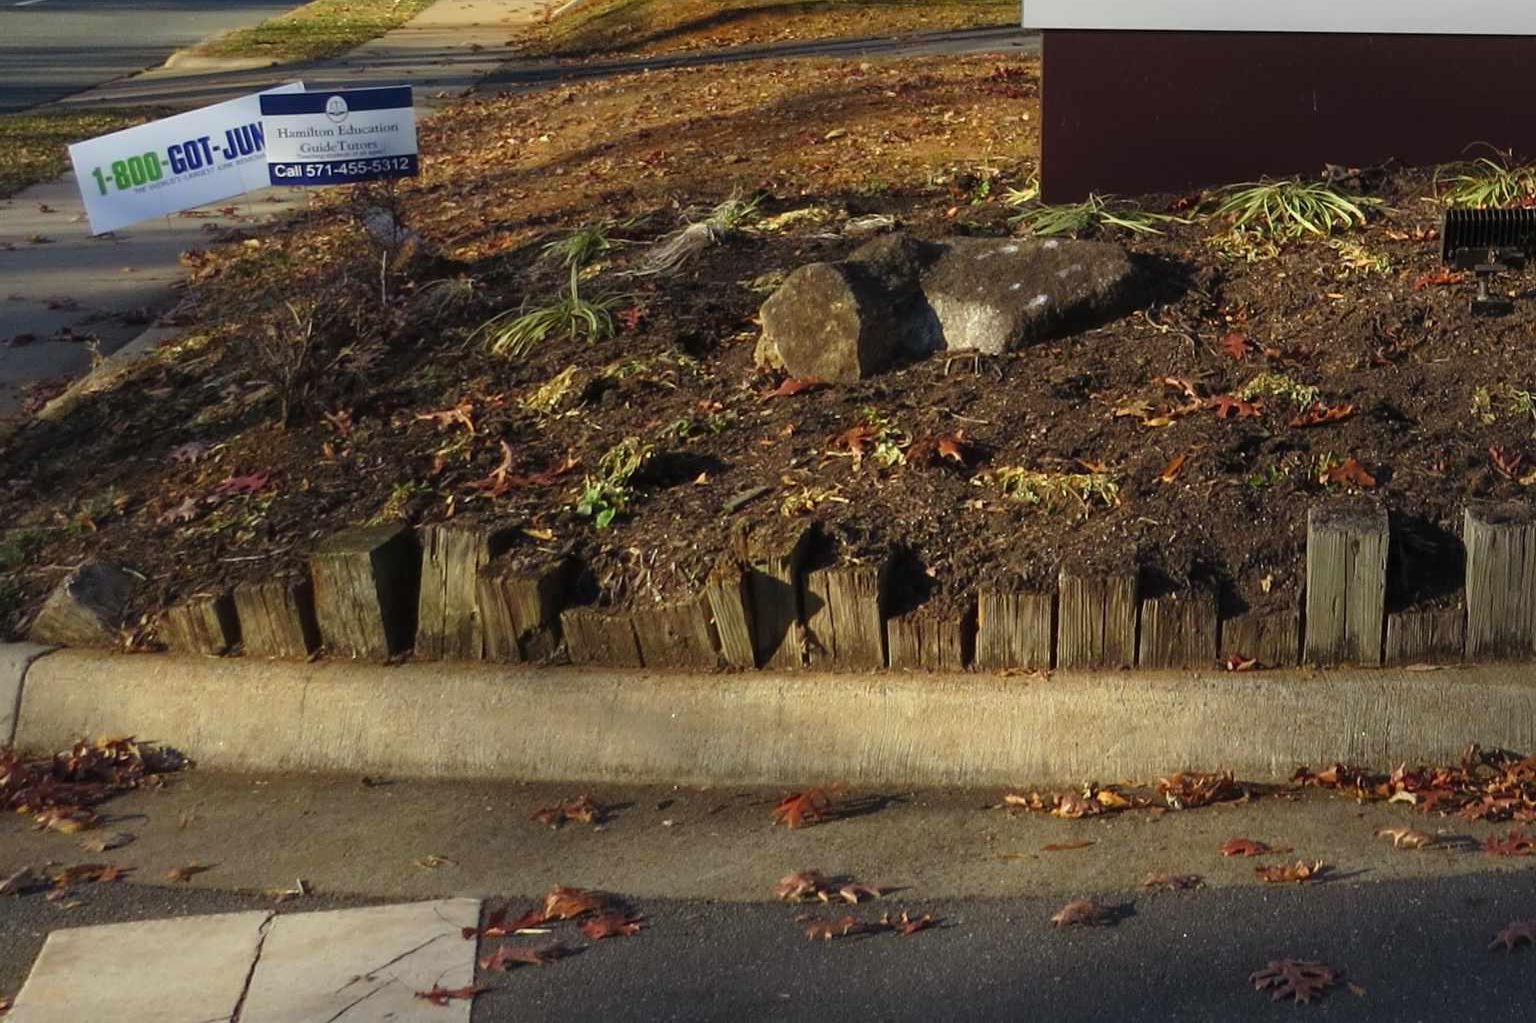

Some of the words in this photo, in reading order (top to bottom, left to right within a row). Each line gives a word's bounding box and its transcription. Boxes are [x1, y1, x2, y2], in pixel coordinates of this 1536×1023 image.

[277, 126, 335, 139] Hamilton
[338, 122, 399, 136] Education
[92, 121, 266, 196] 1-800-GOT-JUN
[275, 164, 303, 177] Call
[306, 157, 409, 177] 571-455-5312
